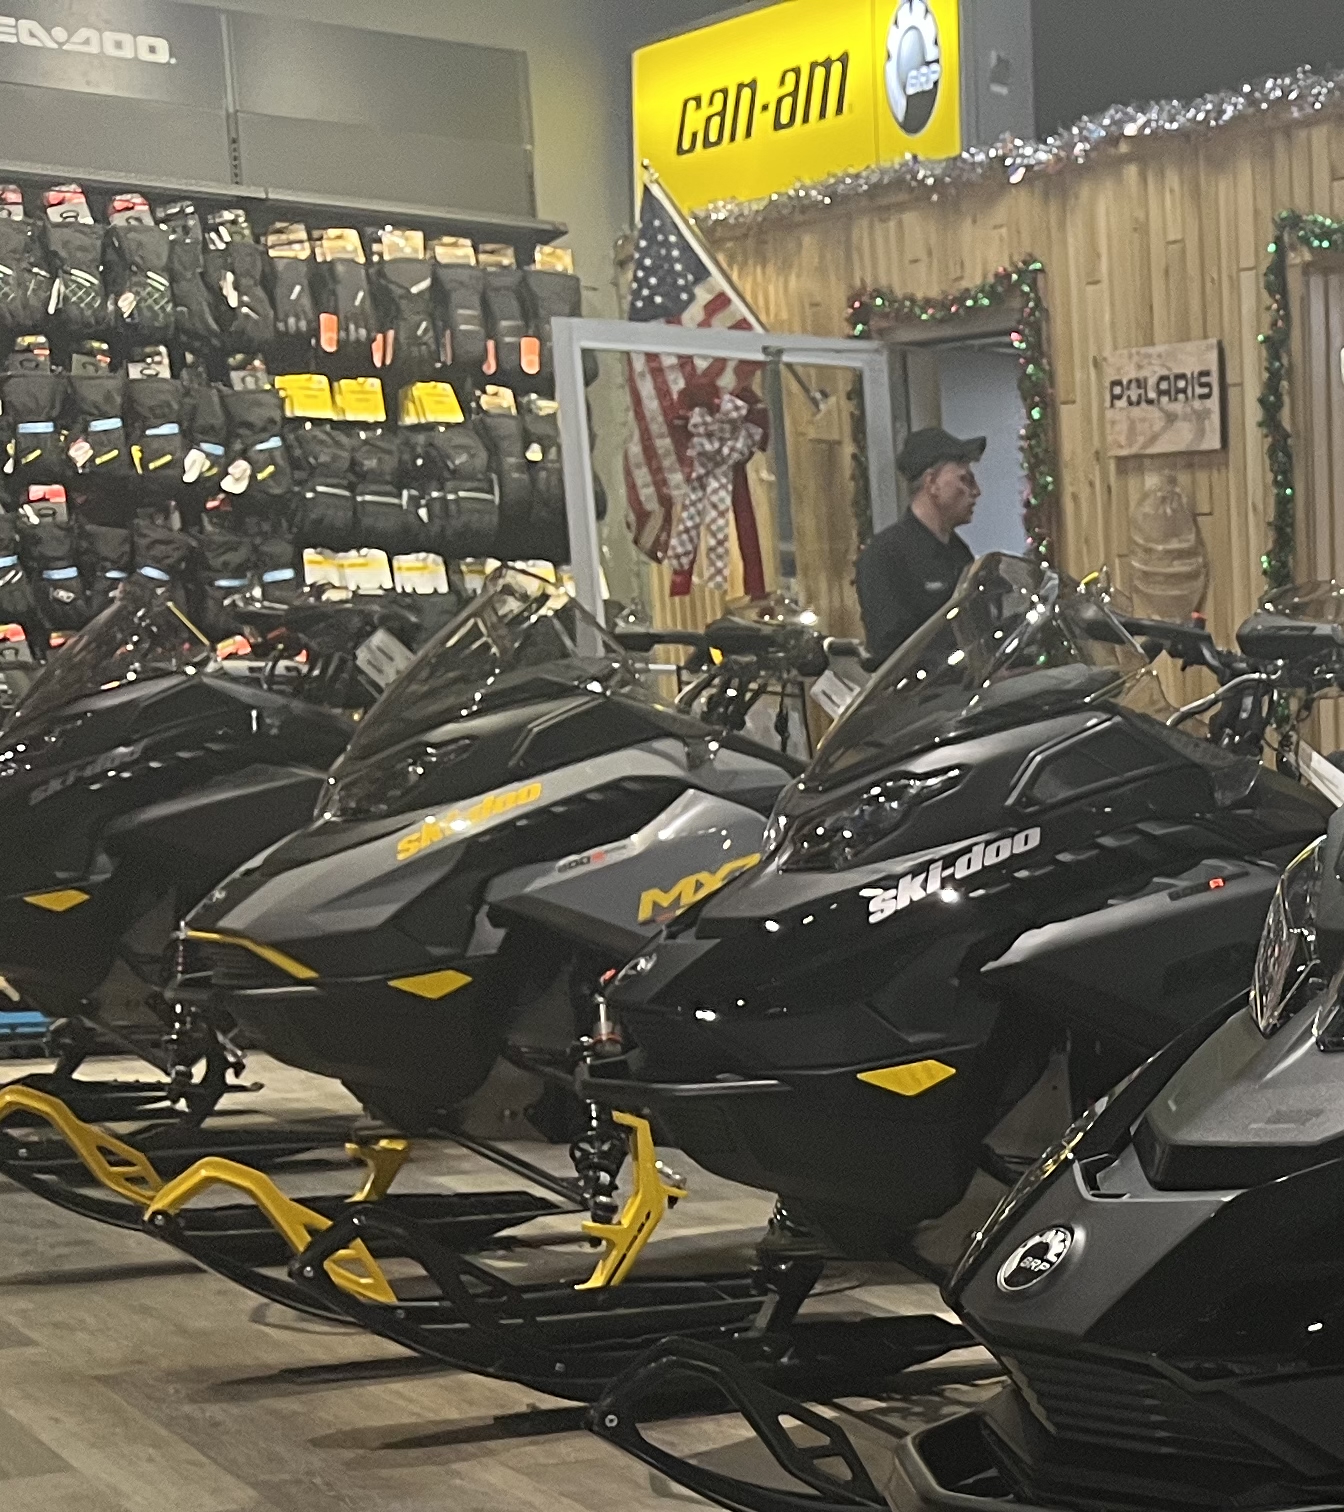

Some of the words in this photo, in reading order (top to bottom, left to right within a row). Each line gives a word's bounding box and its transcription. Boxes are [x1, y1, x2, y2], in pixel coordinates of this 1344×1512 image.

[676, 50, 850, 156] can-am
[1109, 369, 1214, 409] POLARIS
[396, 782, 542, 861] ski-doo
[867, 826, 1041, 924] ski-doo
[1020, 1256, 1051, 1273] BRP
